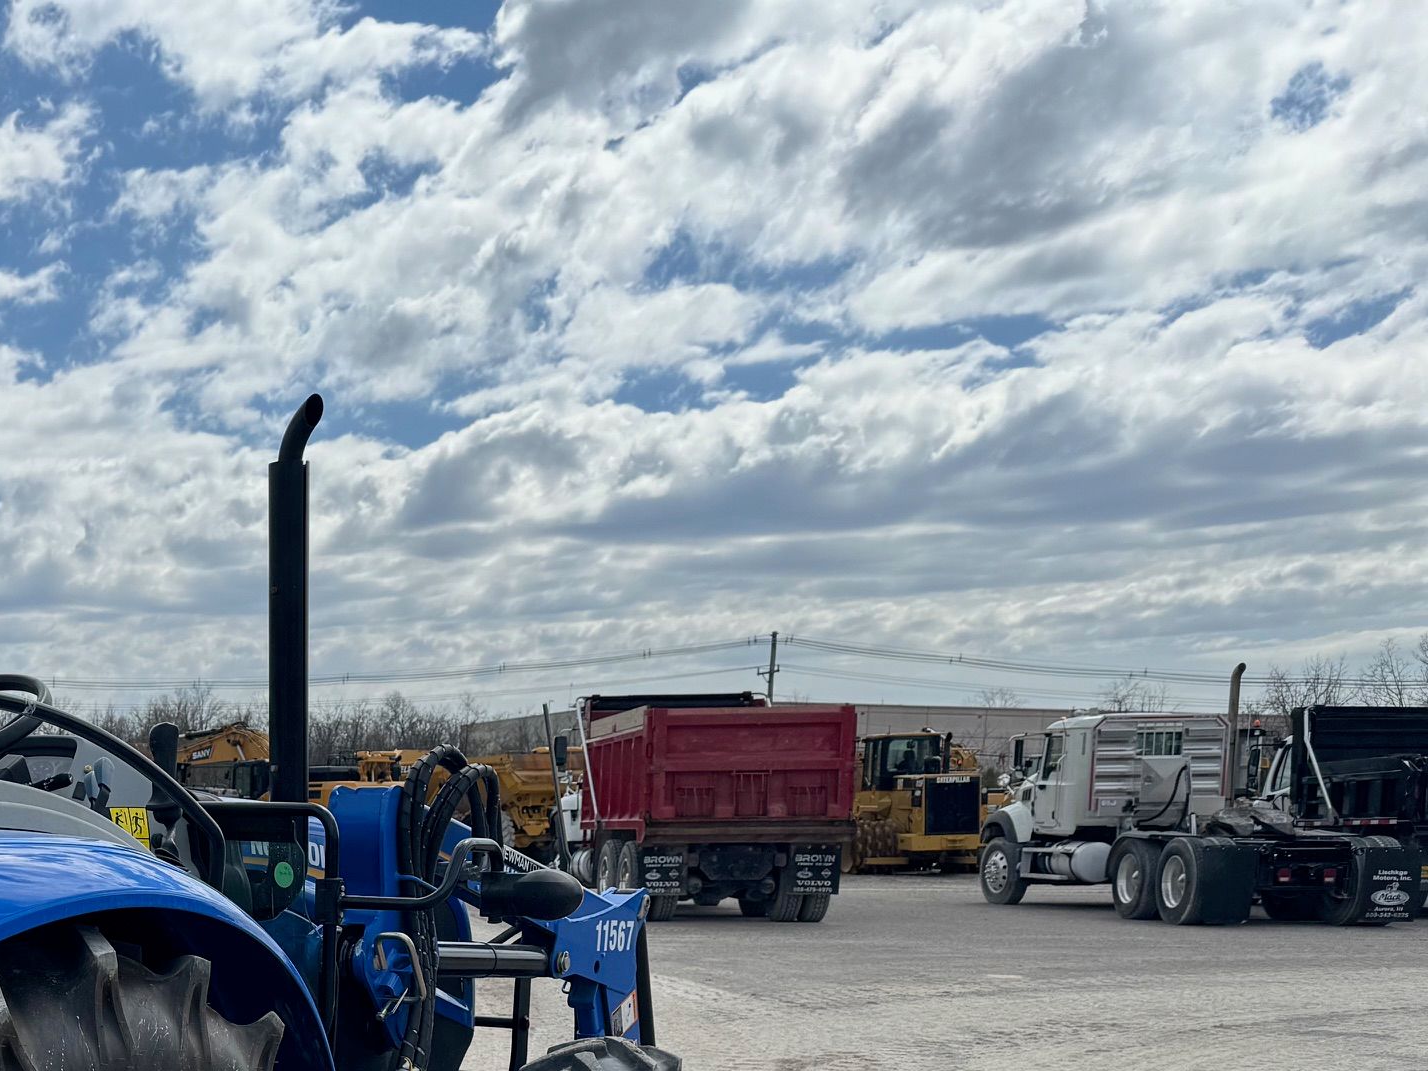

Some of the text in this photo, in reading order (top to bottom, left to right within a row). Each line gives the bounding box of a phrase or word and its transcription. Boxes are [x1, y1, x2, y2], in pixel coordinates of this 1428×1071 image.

[192, 748, 211, 760] SANY
[643, 855, 682, 864] BROWN
[795, 854, 836, 862] BROWN
[596, 920, 635, 952] 11567
